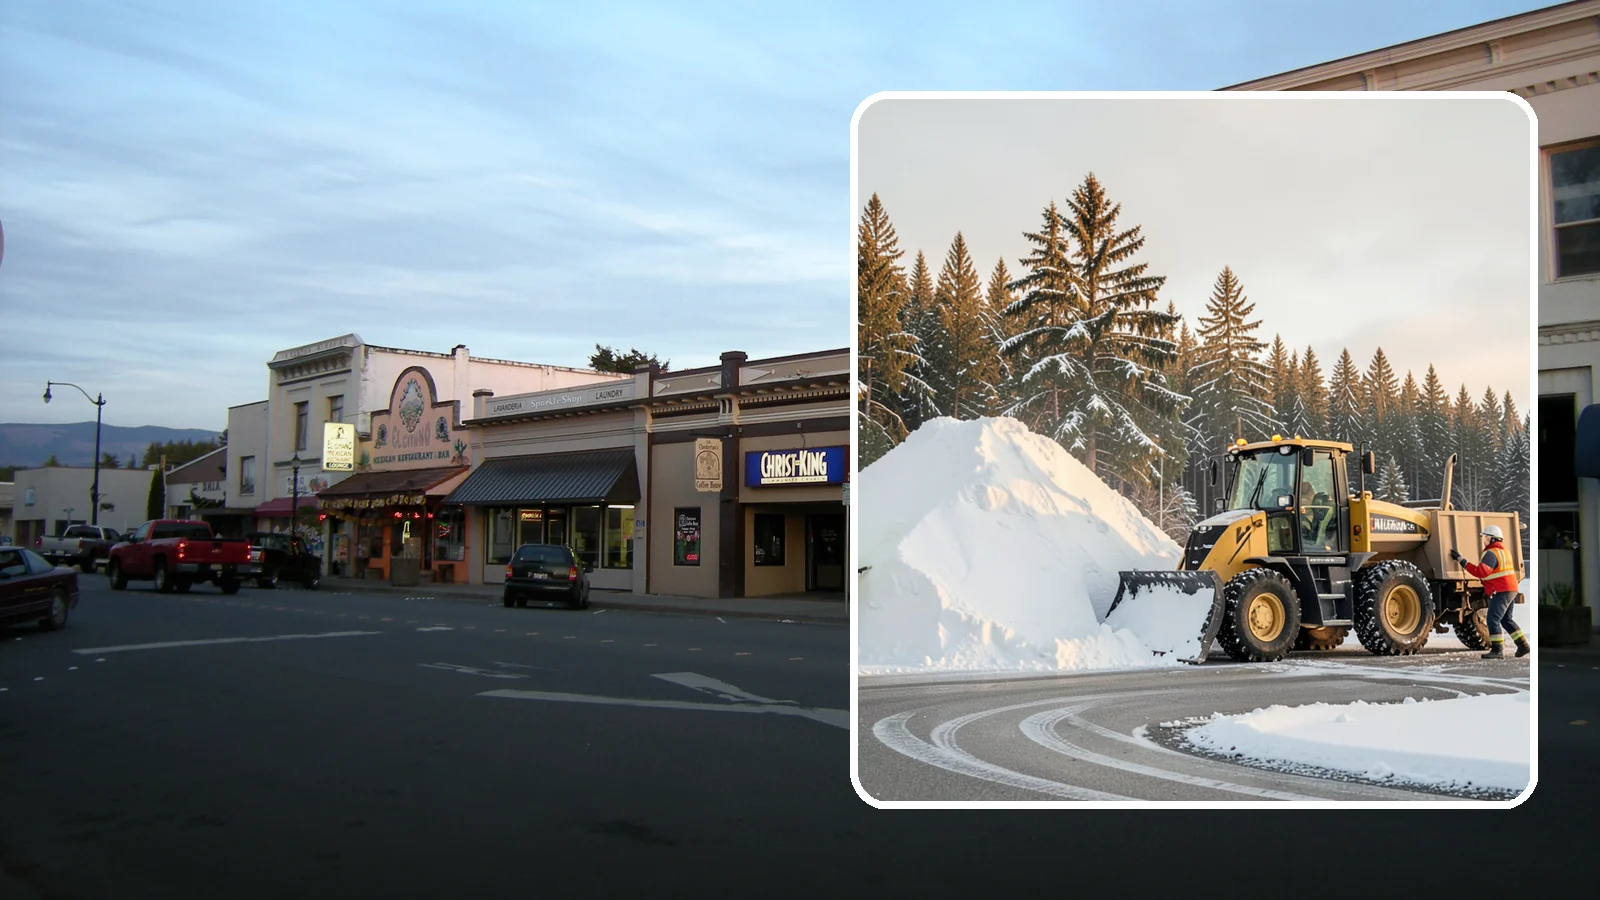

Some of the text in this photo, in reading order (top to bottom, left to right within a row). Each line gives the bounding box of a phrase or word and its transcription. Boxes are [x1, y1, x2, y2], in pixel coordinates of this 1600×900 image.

[531, 394, 582, 409] Sparkle Shop
[595, 389, 623, 400] LAUNDRY
[494, 402, 522, 412] LAVANDERIA
[373, 455, 396, 464] MEXICAN
[397, 451, 434, 463] RESTAURANT
[438, 450, 450, 459] BAR
[761, 450, 827, 478] CHRIST KING
